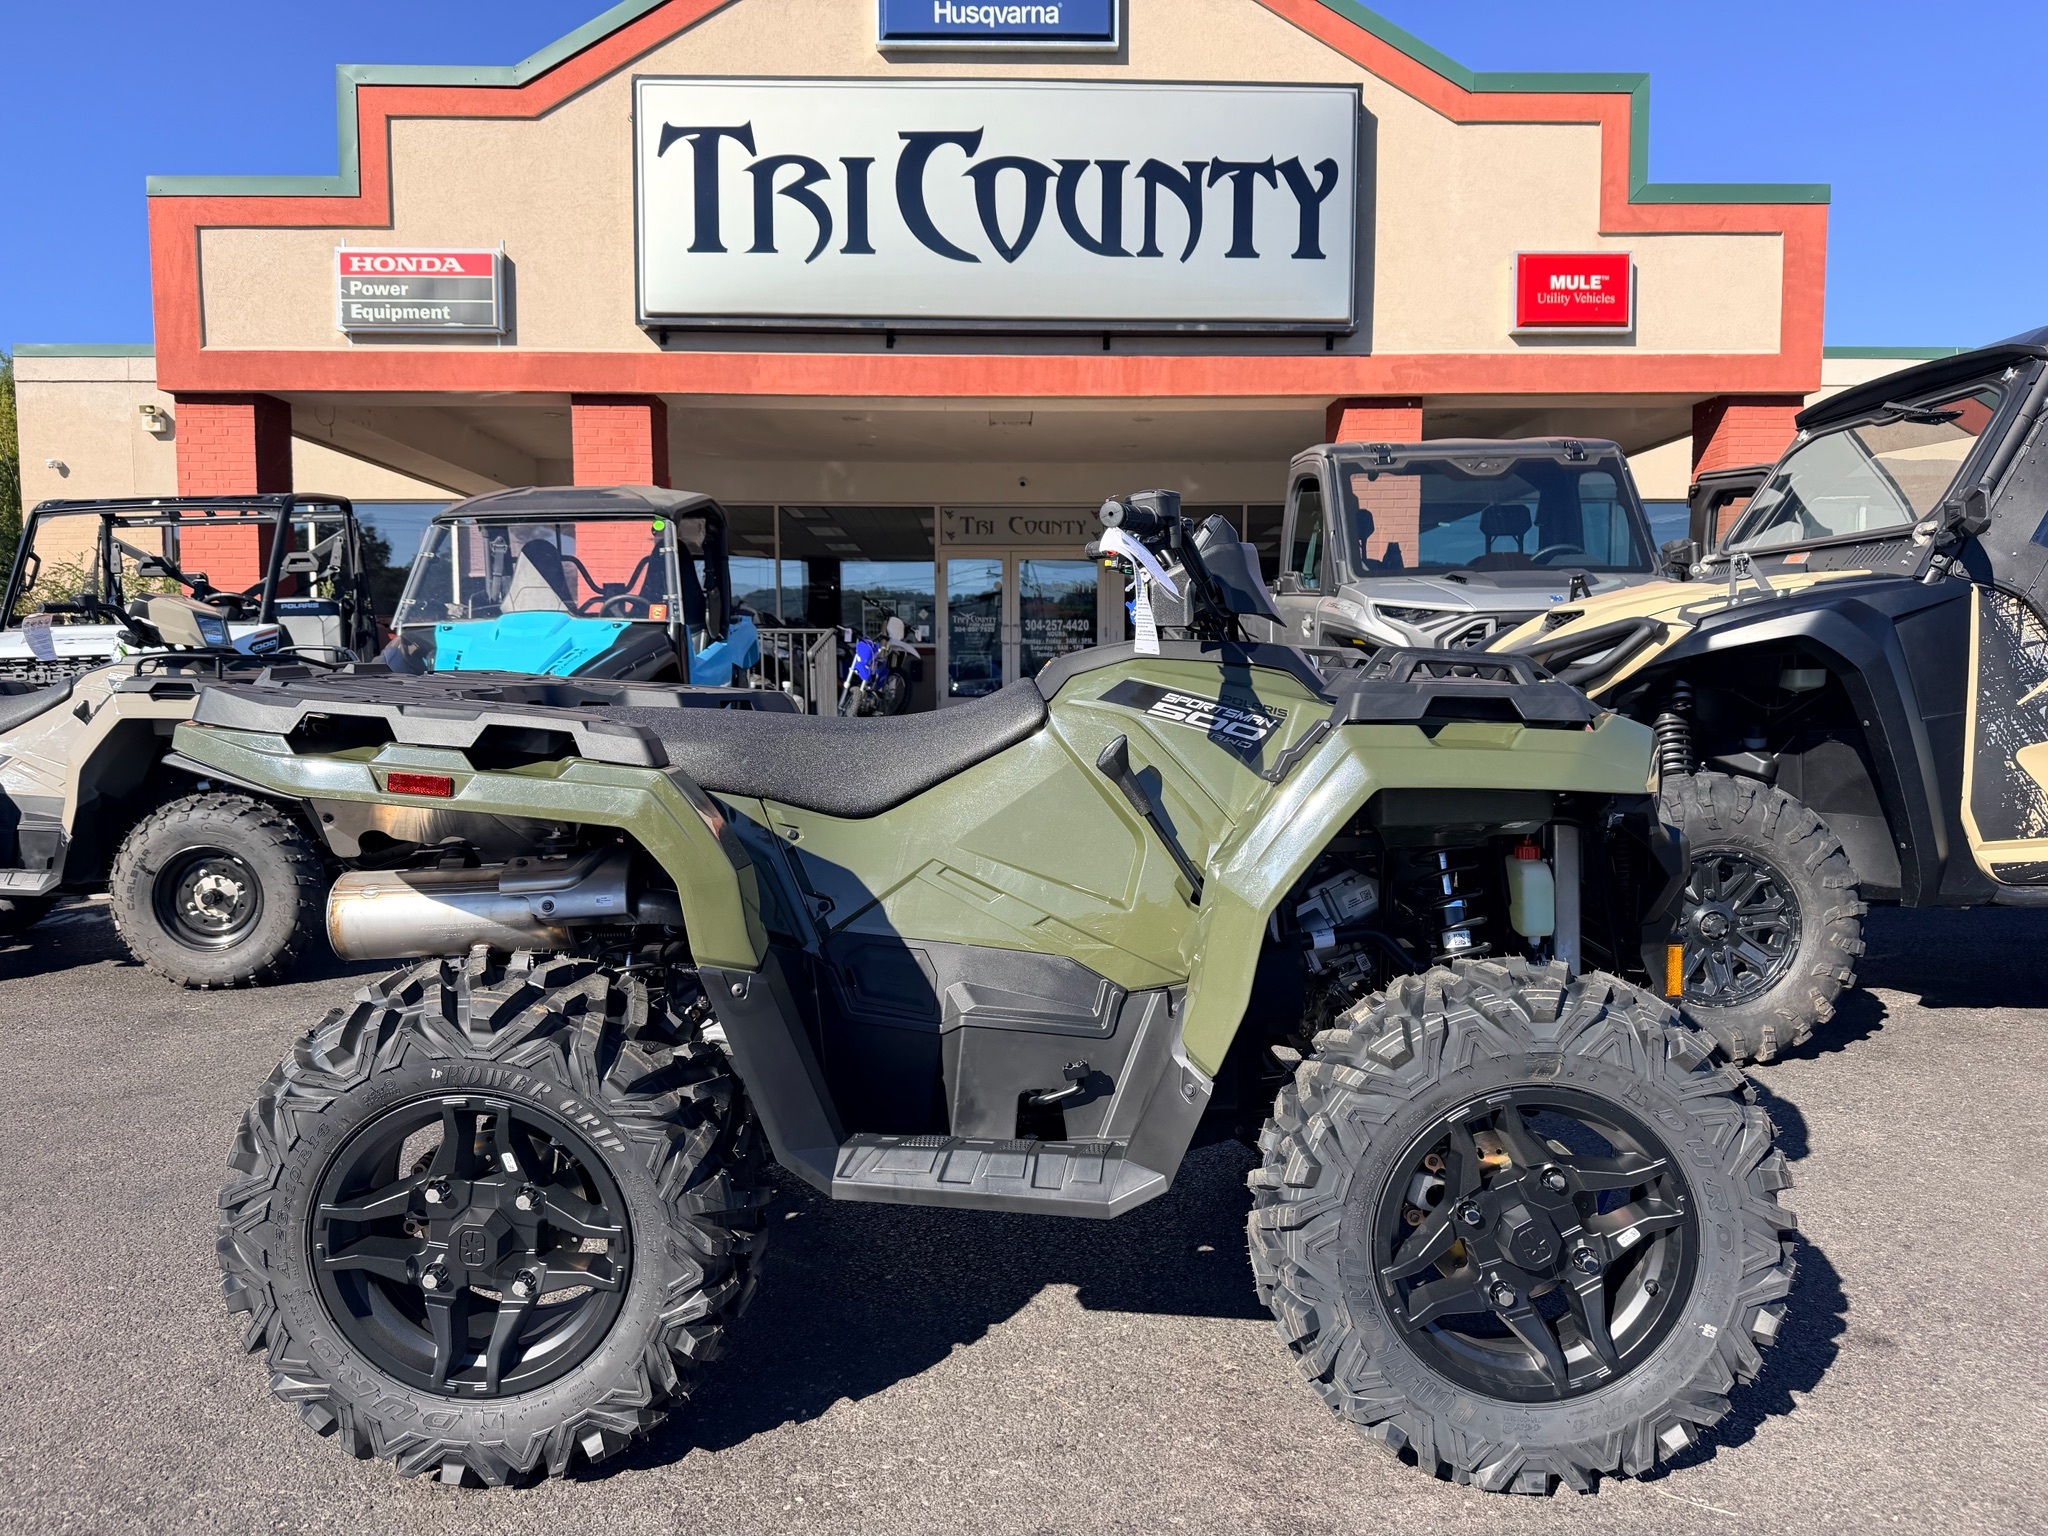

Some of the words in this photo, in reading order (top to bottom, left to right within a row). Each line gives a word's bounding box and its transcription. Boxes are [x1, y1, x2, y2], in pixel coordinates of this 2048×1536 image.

[933, 1, 1060, 28] Husqvarna
[657, 119, 876, 264] TRI
[895, 126, 1339, 263] COUNTY
[349, 256, 465, 272] HONDA
[350, 281, 409, 296] Power
[1537, 292, 1571, 306] Utility
[1574, 292, 1616, 304] Vehicles
[351, 303, 451, 322] Equipment
[1025, 619, 1089, 631] 304-257-4420
[1161, 693, 1278, 729] SPORTSMAN
[1221, 694, 1289, 717] POLARIS
[1147, 702, 1267, 741] 500
[1210, 734, 1253, 749] AWD
[440, 1064, 553, 1101] POWER
[558, 1099, 627, 1153] GRIP
